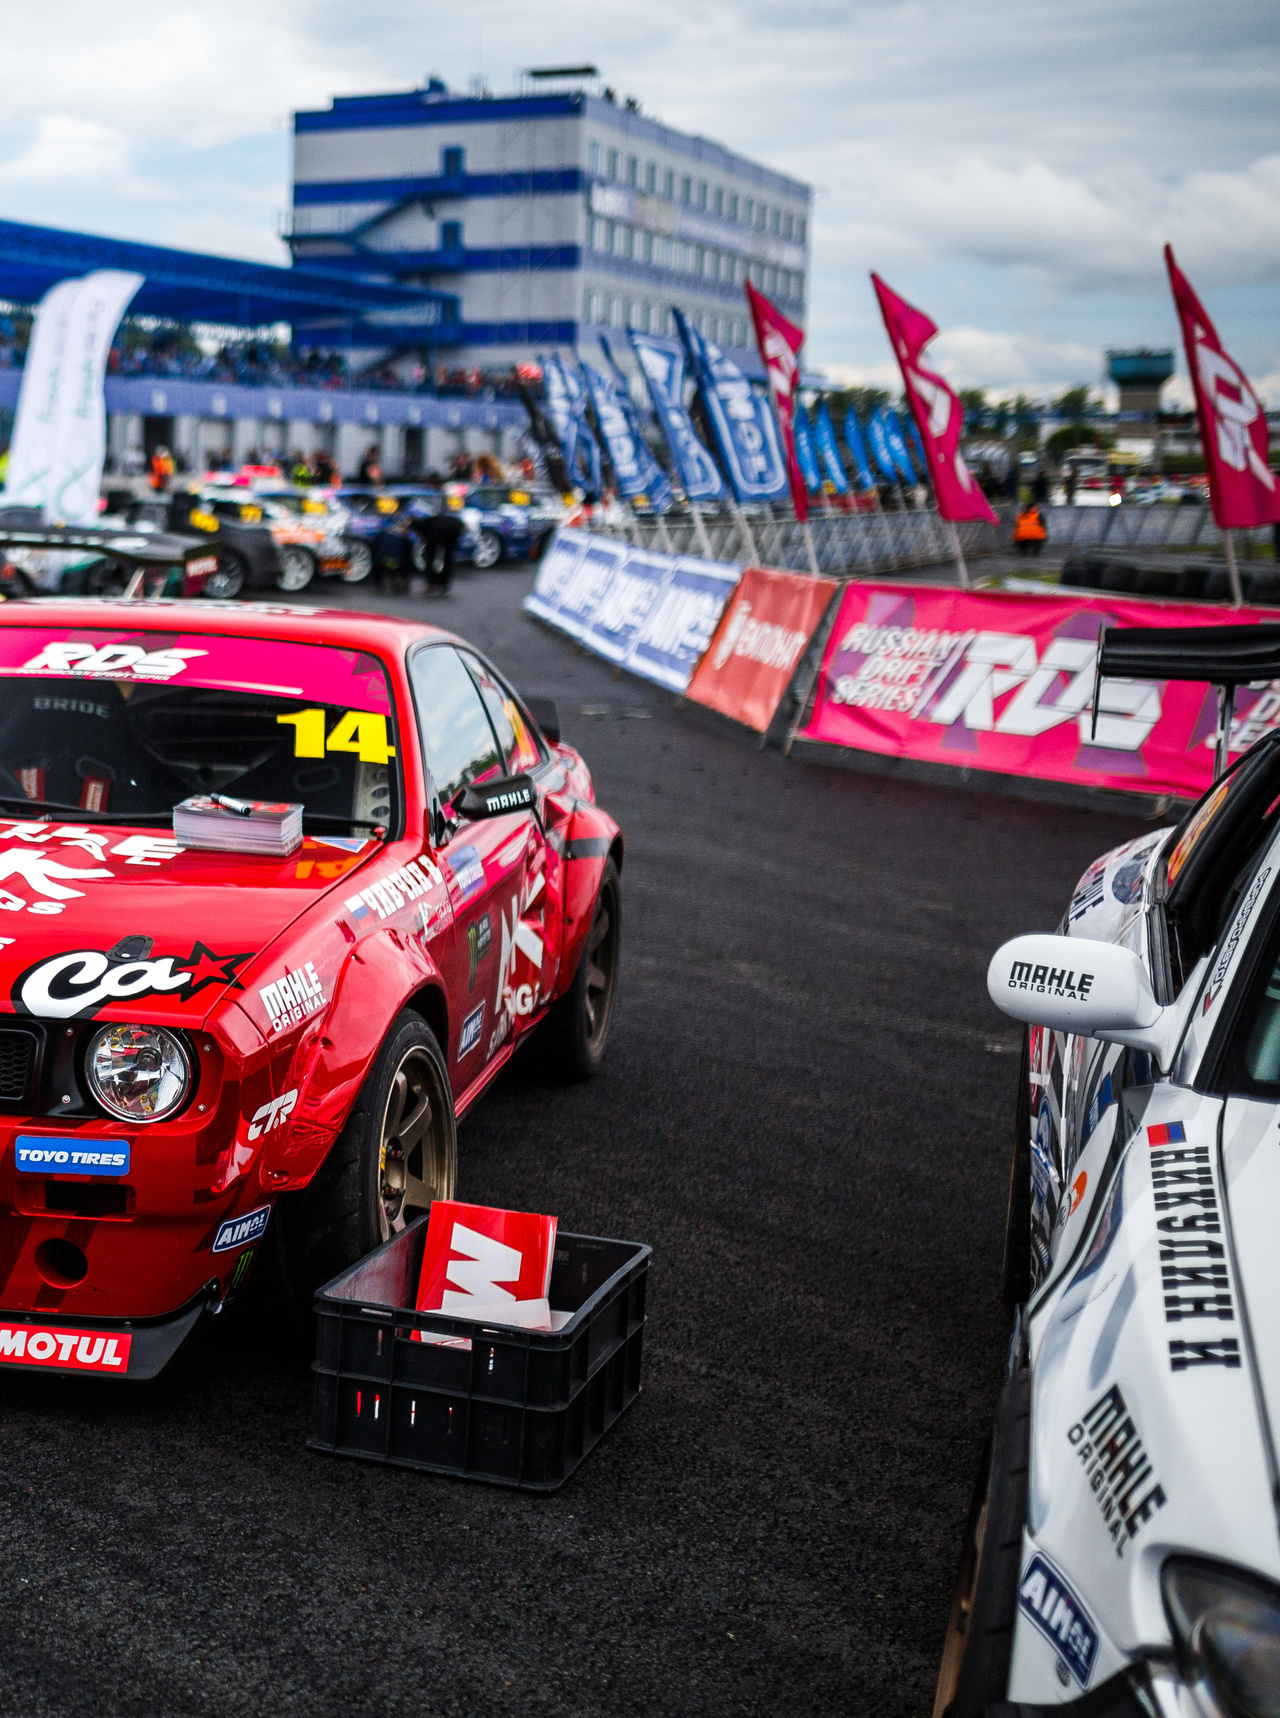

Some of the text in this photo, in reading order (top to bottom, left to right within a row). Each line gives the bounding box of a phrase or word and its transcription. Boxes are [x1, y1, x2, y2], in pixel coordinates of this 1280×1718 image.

[23, 642, 210, 676] RDS
[841, 622, 956, 661] RUSSIAN
[859, 654, 944, 685] DRIFT
[33, 697, 110, 718] BRIDE
[832, 677, 922, 712] SERIES
[931, 630, 1162, 751] RDS
[277, 708, 396, 765] 14
[486, 788, 531, 812] MAHLE
[258, 961, 323, 1020] MAHLE
[1008, 980, 1088, 1002] ORIGINAL
[1010, 961, 1094, 993] MAHLE
[271, 992, 327, 1033] ORIGINAL
[18, 1149, 126, 1166] TOYO TIRES
[1150, 1145, 1242, 1373] НИКУЛИН И
[1081, 1384, 1167, 1539] MAHLE
[1067, 1423, 1125, 1557] ORIGINAL
